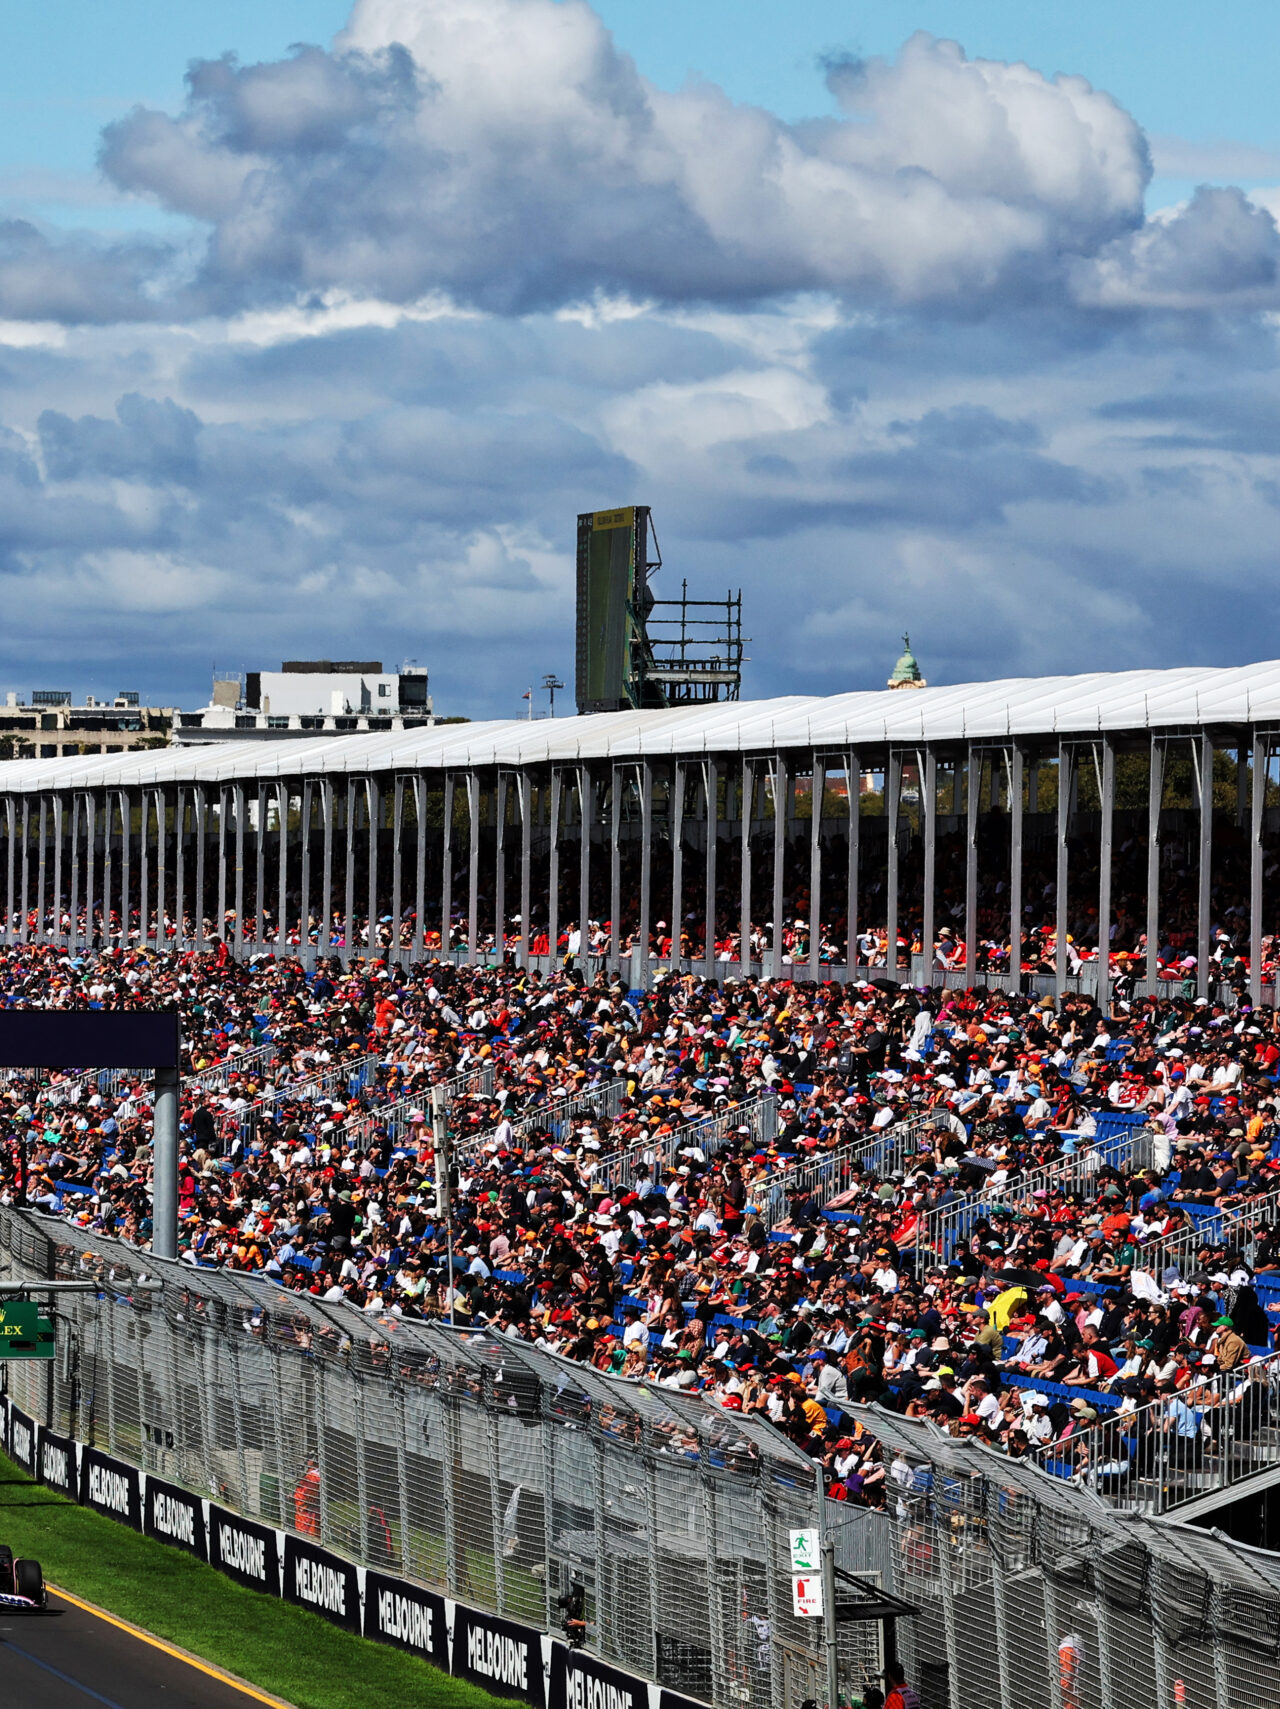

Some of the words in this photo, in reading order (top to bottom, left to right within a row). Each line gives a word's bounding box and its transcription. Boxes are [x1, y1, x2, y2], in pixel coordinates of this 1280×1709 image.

[89, 1463, 129, 1516] MELBOURNE
[153, 1490, 195, 1546] MELBOURNE
[219, 1521, 266, 1581] MELBOURNE
[295, 1555, 346, 1616] MELBOURNE
[378, 1585, 433, 1653] MELBOURNE
[467, 1622, 528, 1690] MELBOURNE
